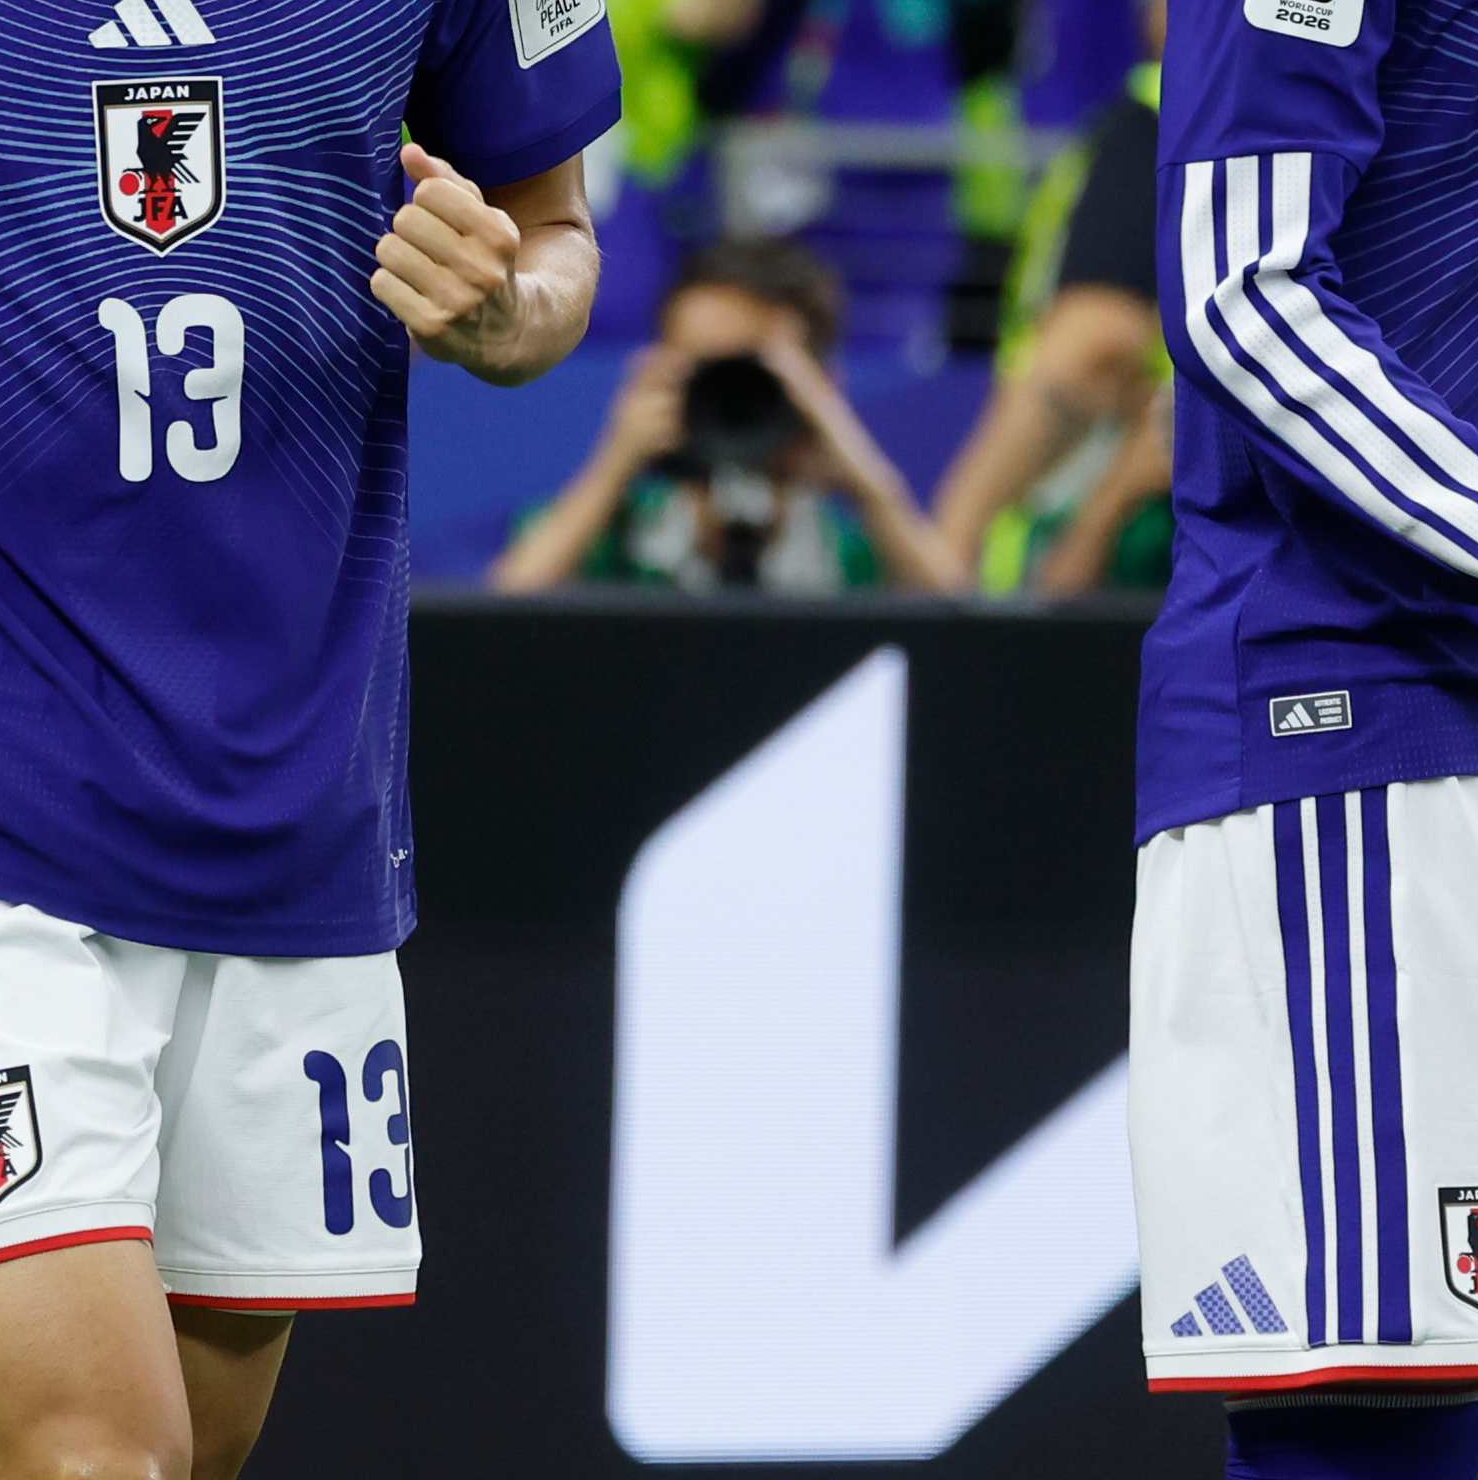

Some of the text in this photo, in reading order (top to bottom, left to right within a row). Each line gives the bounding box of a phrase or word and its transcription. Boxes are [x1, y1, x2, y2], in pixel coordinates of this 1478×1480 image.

[1275, 8, 1331, 31] 2026
[1315, 6, 1334, 17] CUP
[550, 17, 574, 37] FIFA
[124, 85, 190, 101] JAPAN
[133, 196, 188, 222] JFA
[98, 293, 245, 482] 13
[303, 1039, 413, 1236] 13
